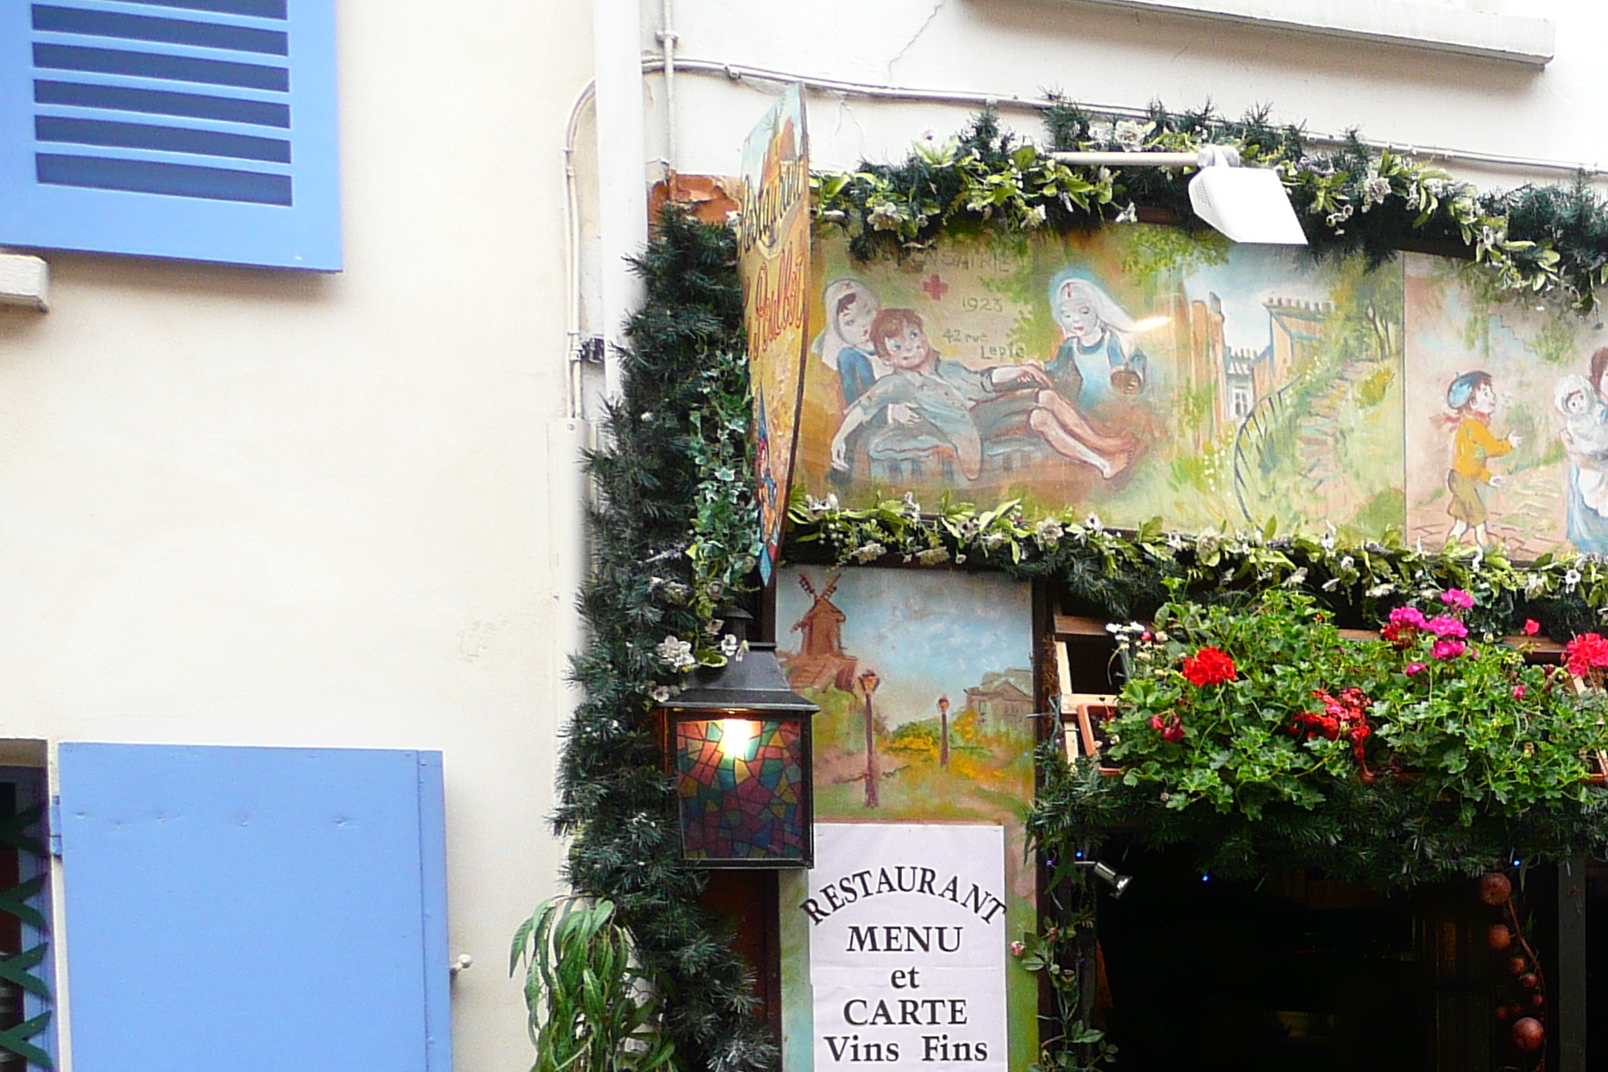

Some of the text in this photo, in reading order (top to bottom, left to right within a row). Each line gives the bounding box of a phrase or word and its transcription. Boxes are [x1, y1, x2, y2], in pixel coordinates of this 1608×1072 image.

[962, 295, 1003, 313] 1923
[942, 327, 962, 344] 42
[799, 866, 1007, 926] RESTAURANT
[846, 925, 964, 952] MENU
[890, 966, 921, 989] et
[843, 999, 968, 1026] CARTE
[823, 1034, 988, 1062] Vins Fins
